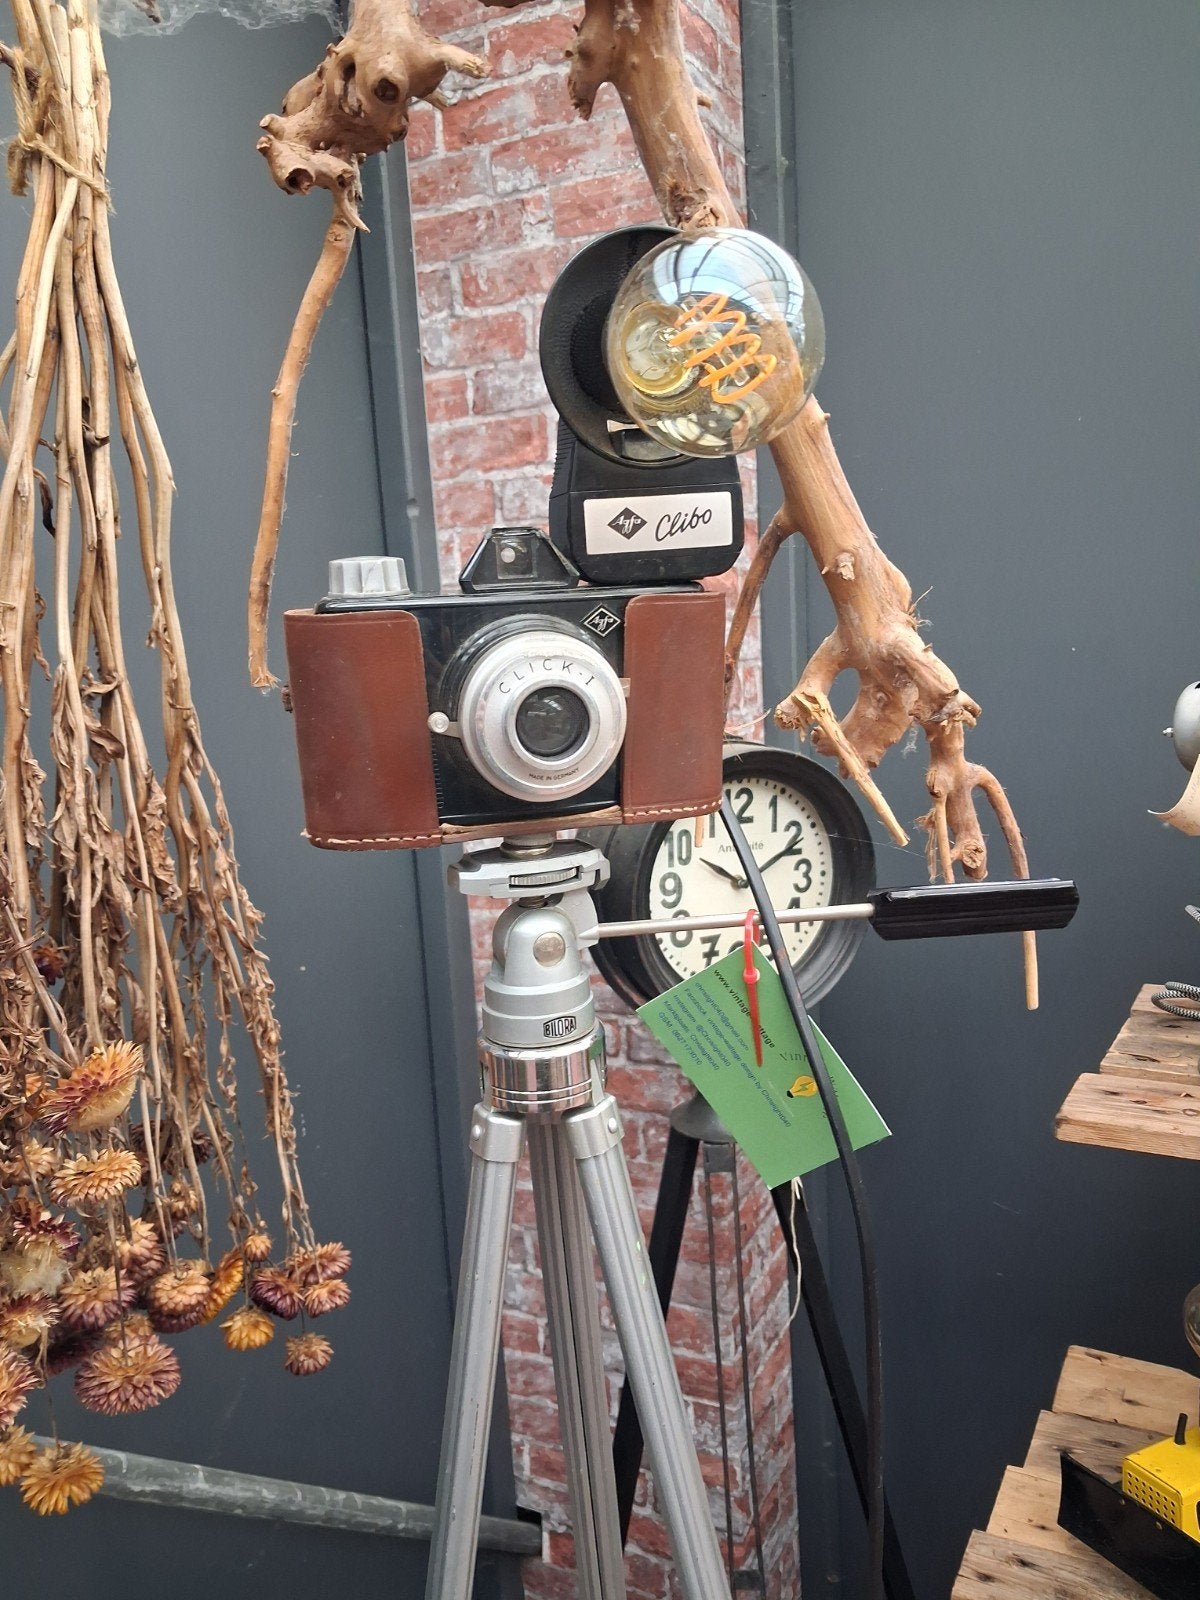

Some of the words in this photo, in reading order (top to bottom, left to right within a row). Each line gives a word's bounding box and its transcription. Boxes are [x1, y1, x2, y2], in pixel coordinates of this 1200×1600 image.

[612, 514, 642, 534] Agfa
[655, 507, 713, 542] Clibo
[499, 658, 595, 694] CLICK-I
[529, 773, 544, 781] MADE
[553, 767, 580, 781] GERMANY
[768, 794, 778, 833] 1
[663, 828, 693, 869] 10
[718, 841, 764, 853] Anité
[784, 820, 803, 857] 2
[659, 872, 683, 910] 9
[793, 858, 812, 893] 3
[700, 932, 722, 969] 7
[545, 1018, 575, 1037] BILORA
